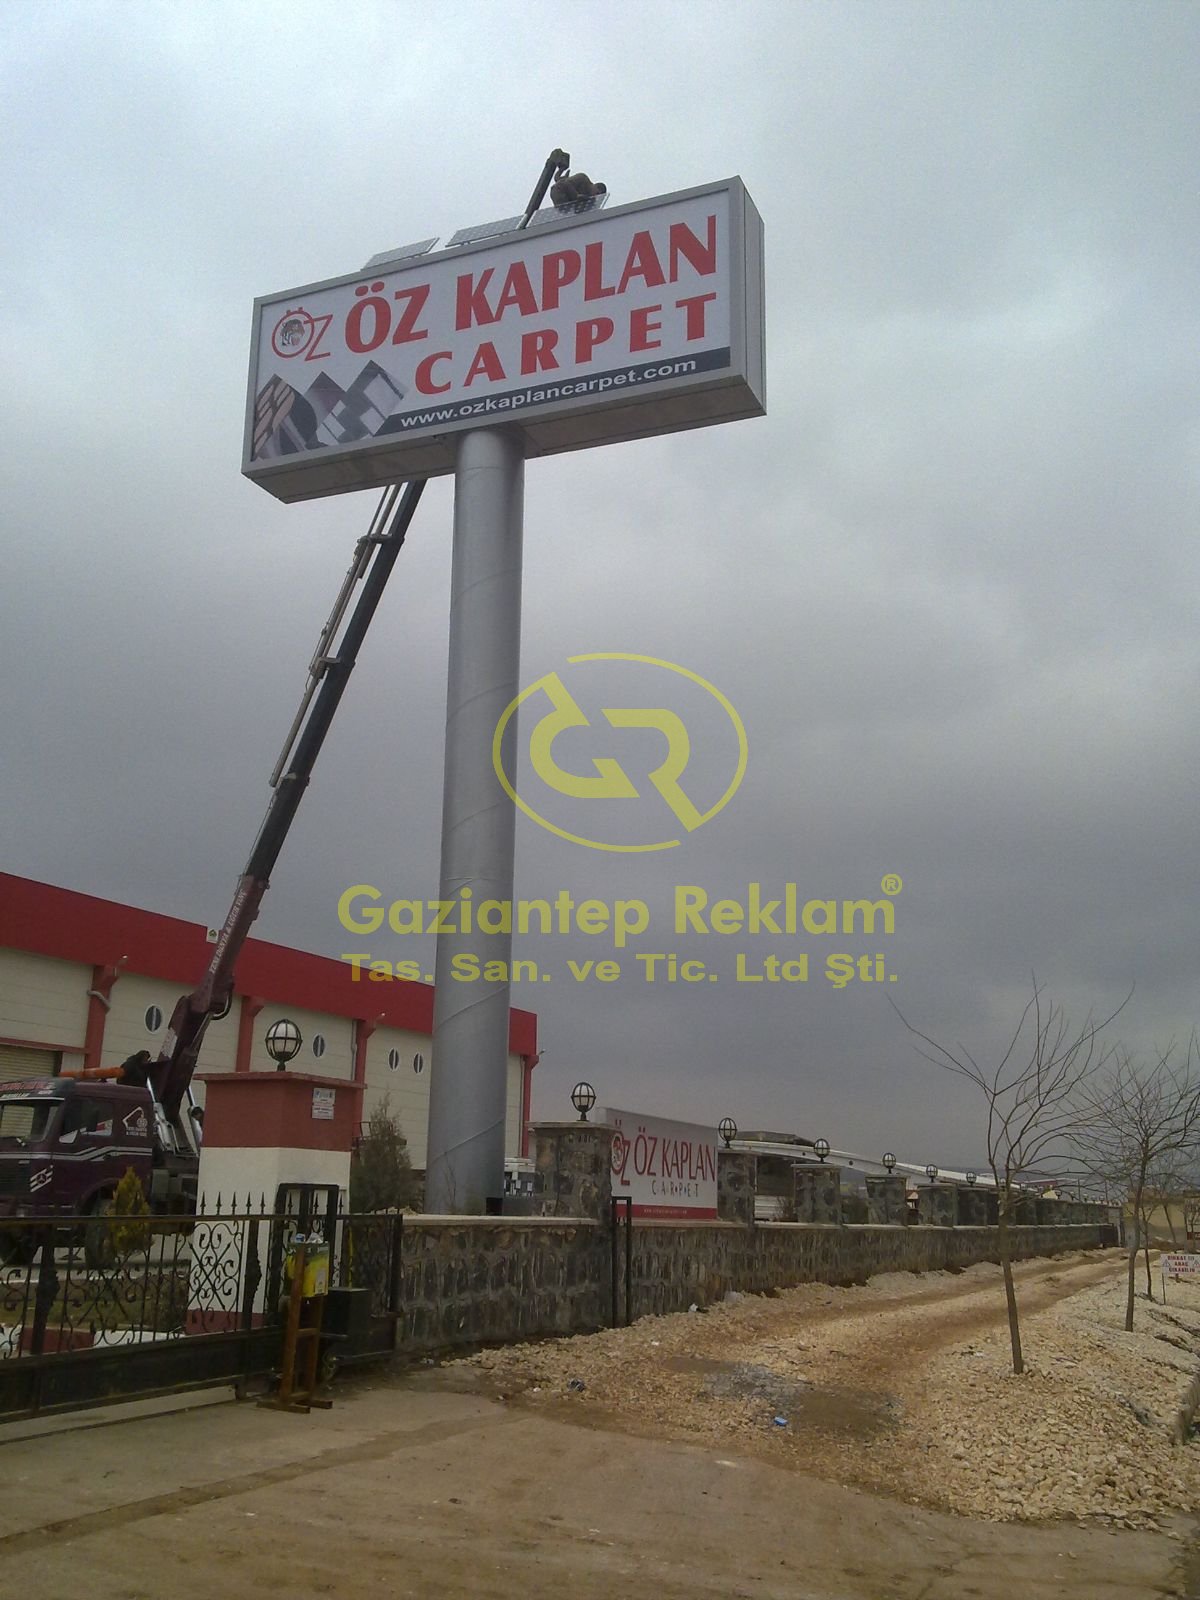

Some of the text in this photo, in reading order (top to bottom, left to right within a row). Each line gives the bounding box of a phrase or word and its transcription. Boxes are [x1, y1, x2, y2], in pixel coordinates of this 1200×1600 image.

[345, 215, 717, 354] ÖZ KAPLAN
[415, 292, 716, 395] CARPET
[401, 359, 696, 427] www.ozkaplancarpet.com
[634, 1126, 716, 1182] ÖZ KAPLAN
